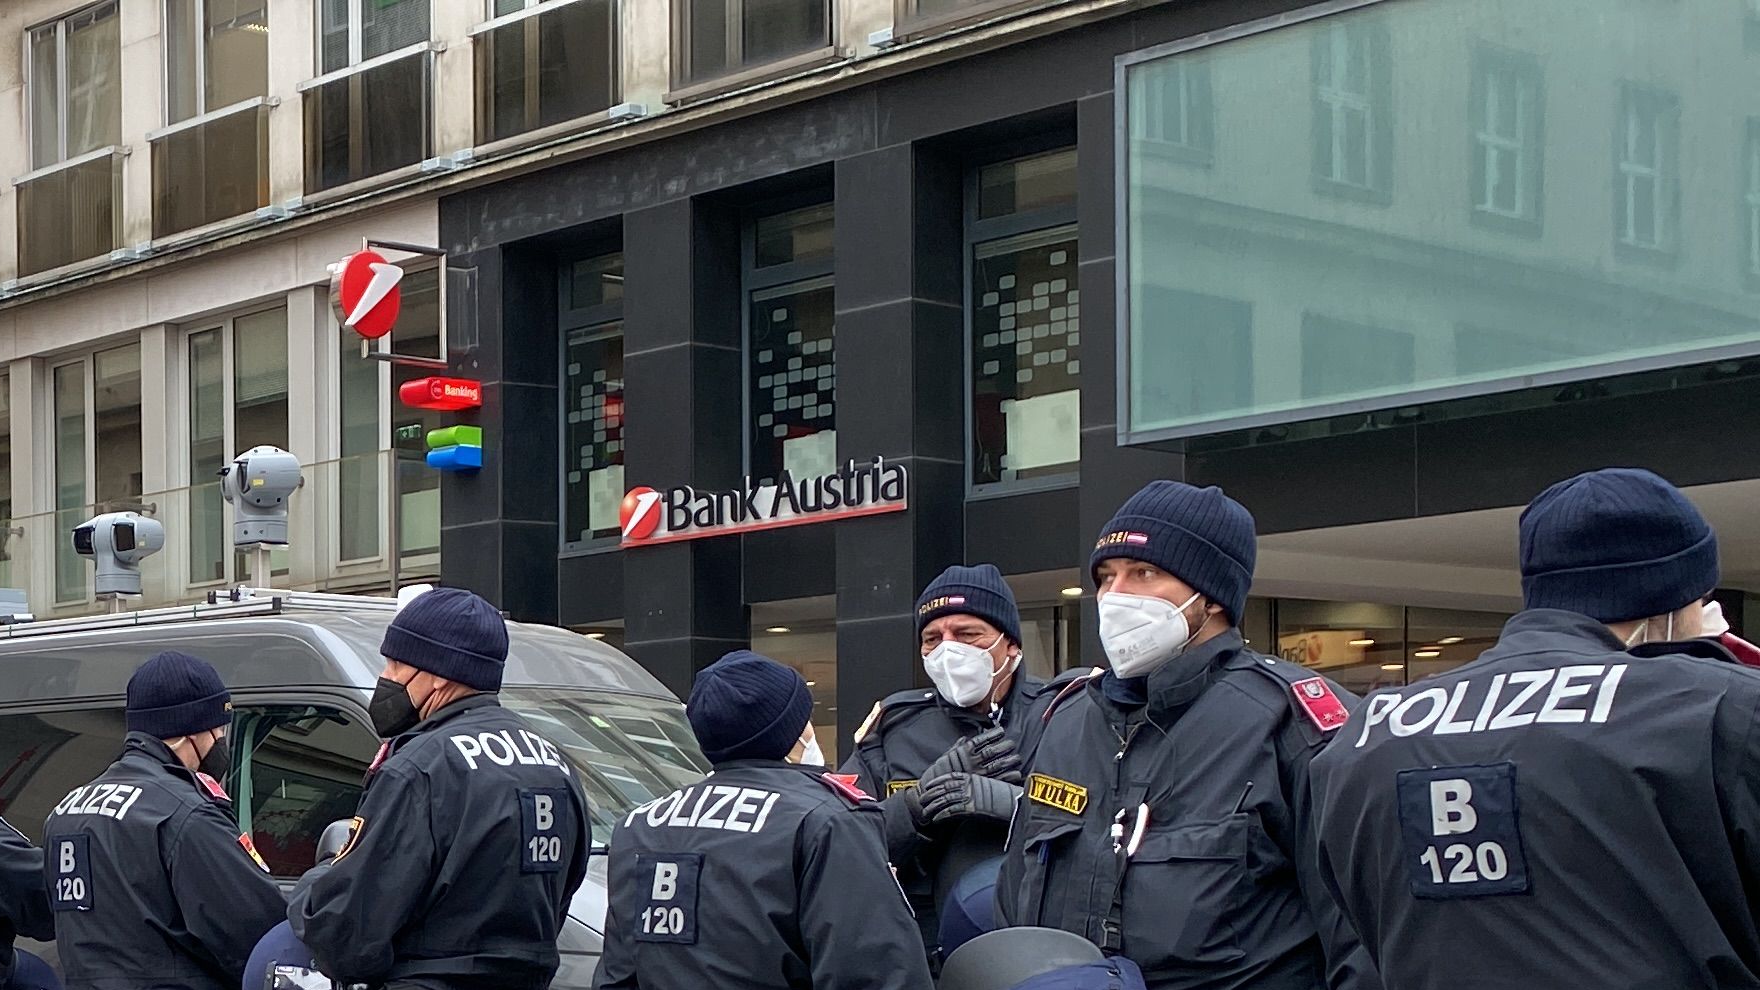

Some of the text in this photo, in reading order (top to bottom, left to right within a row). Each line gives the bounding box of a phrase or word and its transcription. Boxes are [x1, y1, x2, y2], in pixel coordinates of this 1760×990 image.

[444, 384, 478, 401] Banking
[664, 456, 907, 532] Bank Austria
[1355, 664, 1628, 748] POLIZEI
[46, 783, 143, 821] OLIZEI
[534, 794, 554, 831] B
[623, 785, 781, 833] POLIZEI
[1033, 781, 1081, 812] WULKA
[1430, 778, 1478, 836] B
[60, 841, 76, 873] B
[528, 836, 561, 862] 120
[1419, 841, 1508, 884] 120
[56, 877, 86, 901] 120
[651, 862, 679, 900] B
[641, 907, 684, 935] 120
